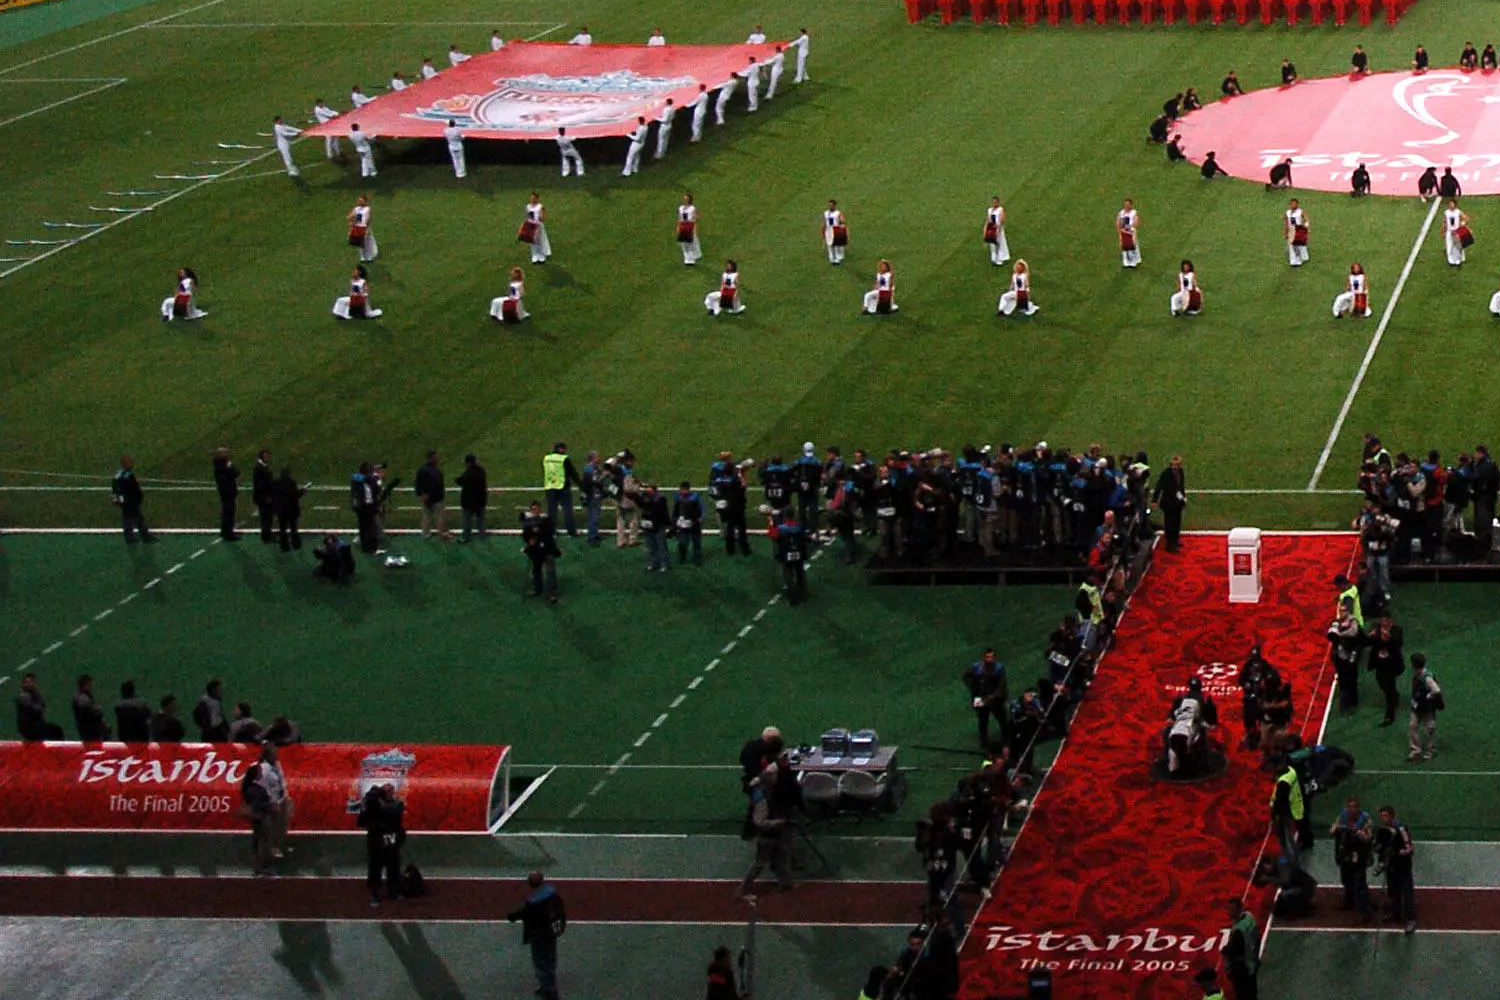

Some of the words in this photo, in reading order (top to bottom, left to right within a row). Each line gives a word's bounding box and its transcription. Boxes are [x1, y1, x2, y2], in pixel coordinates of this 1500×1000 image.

[78, 750, 258, 784] istanbu
[109, 794, 138, 812] The
[144, 793, 183, 812] Final
[189, 796, 230, 813] 2005
[1019, 958, 1061, 972] The
[1067, 958, 1123, 972] Final
[1131, 958, 1190, 972] 2005
